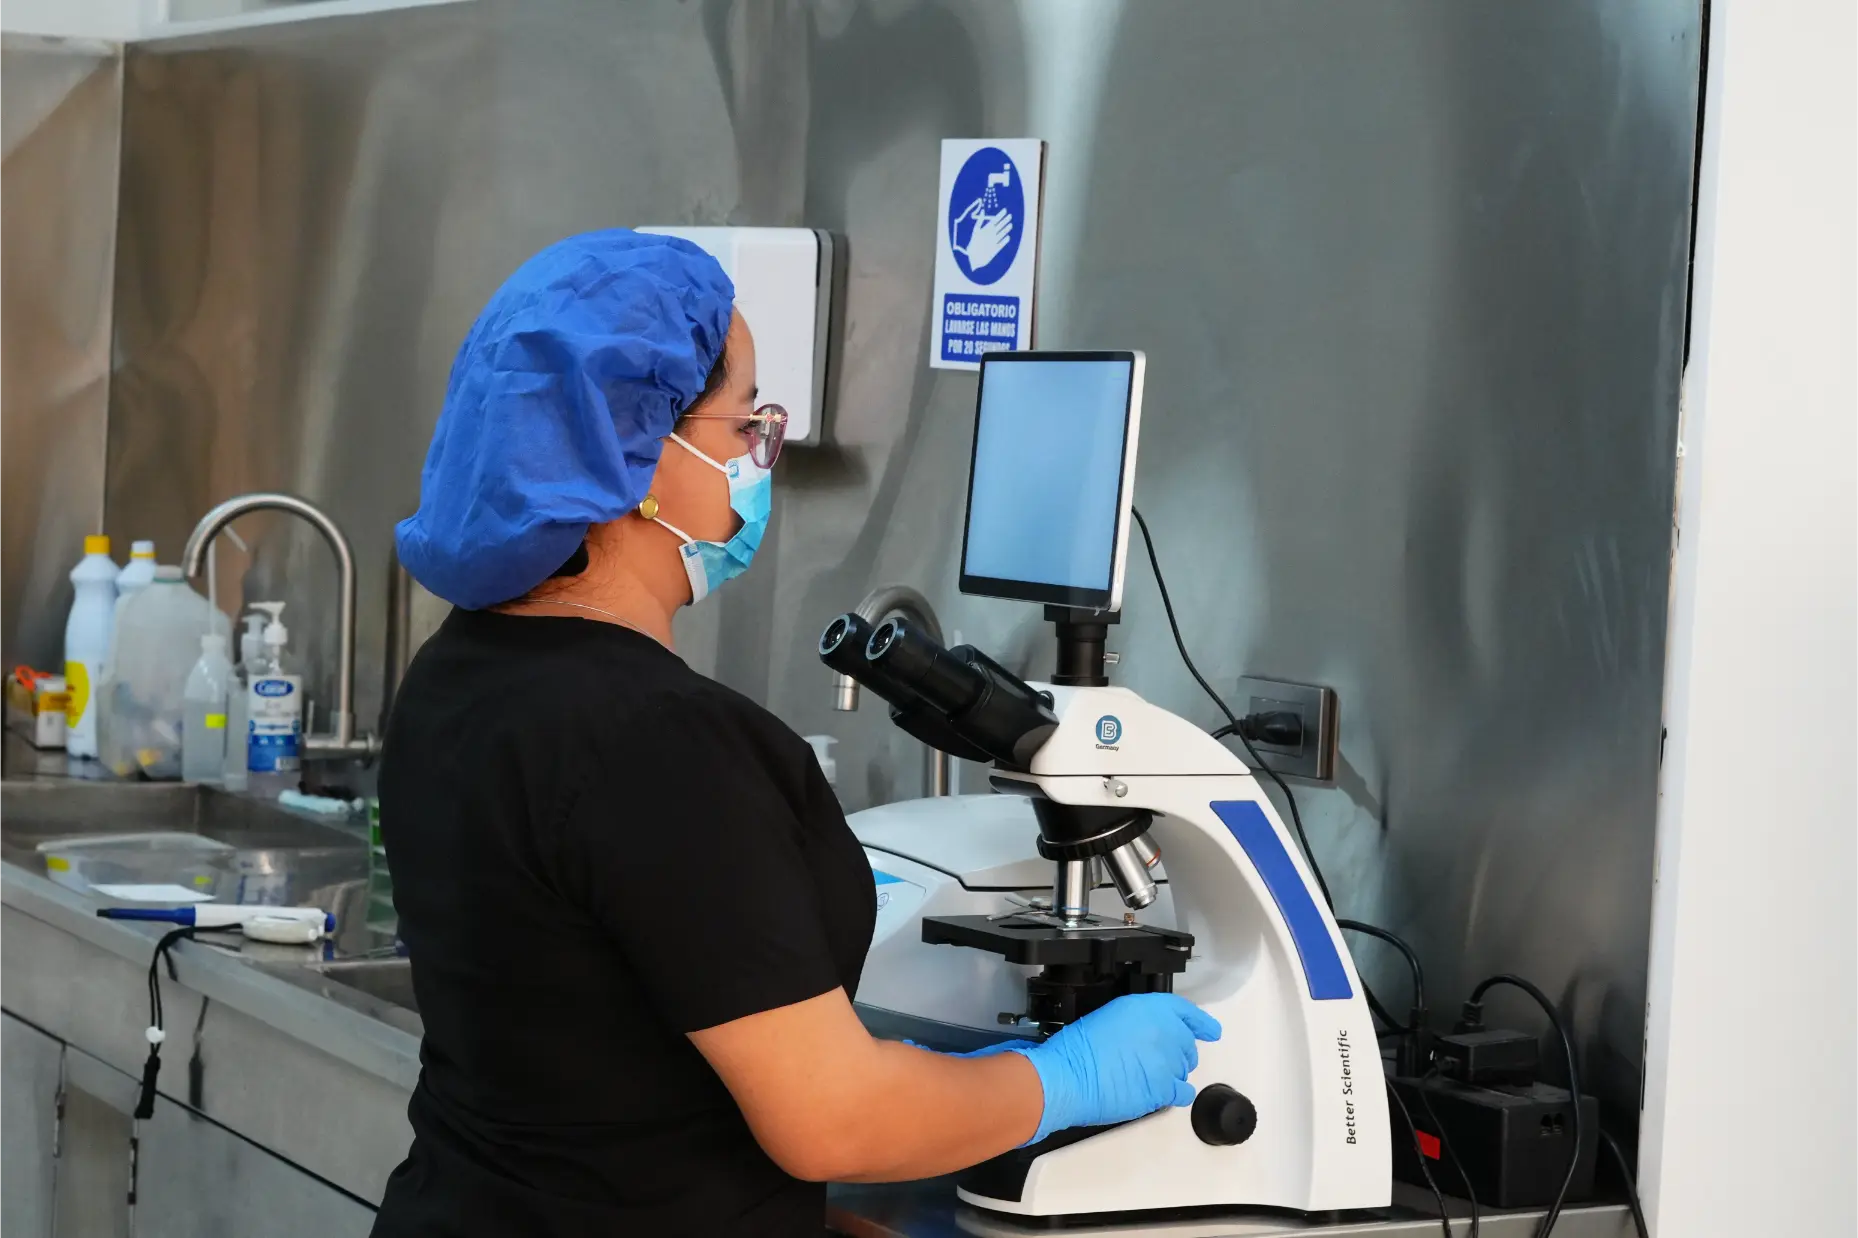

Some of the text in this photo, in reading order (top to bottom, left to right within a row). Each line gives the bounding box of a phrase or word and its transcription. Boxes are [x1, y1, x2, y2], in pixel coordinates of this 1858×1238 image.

[946, 301, 1017, 318] OBLIGATORIO
[945, 319, 1016, 338] LAVARSE LAS MANOS
[947, 338, 963, 354] POR
[964, 340, 974, 355] 20
[1095, 743, 1120, 752] Germany
[1337, 1029, 1357, 1145] Better Scientific
